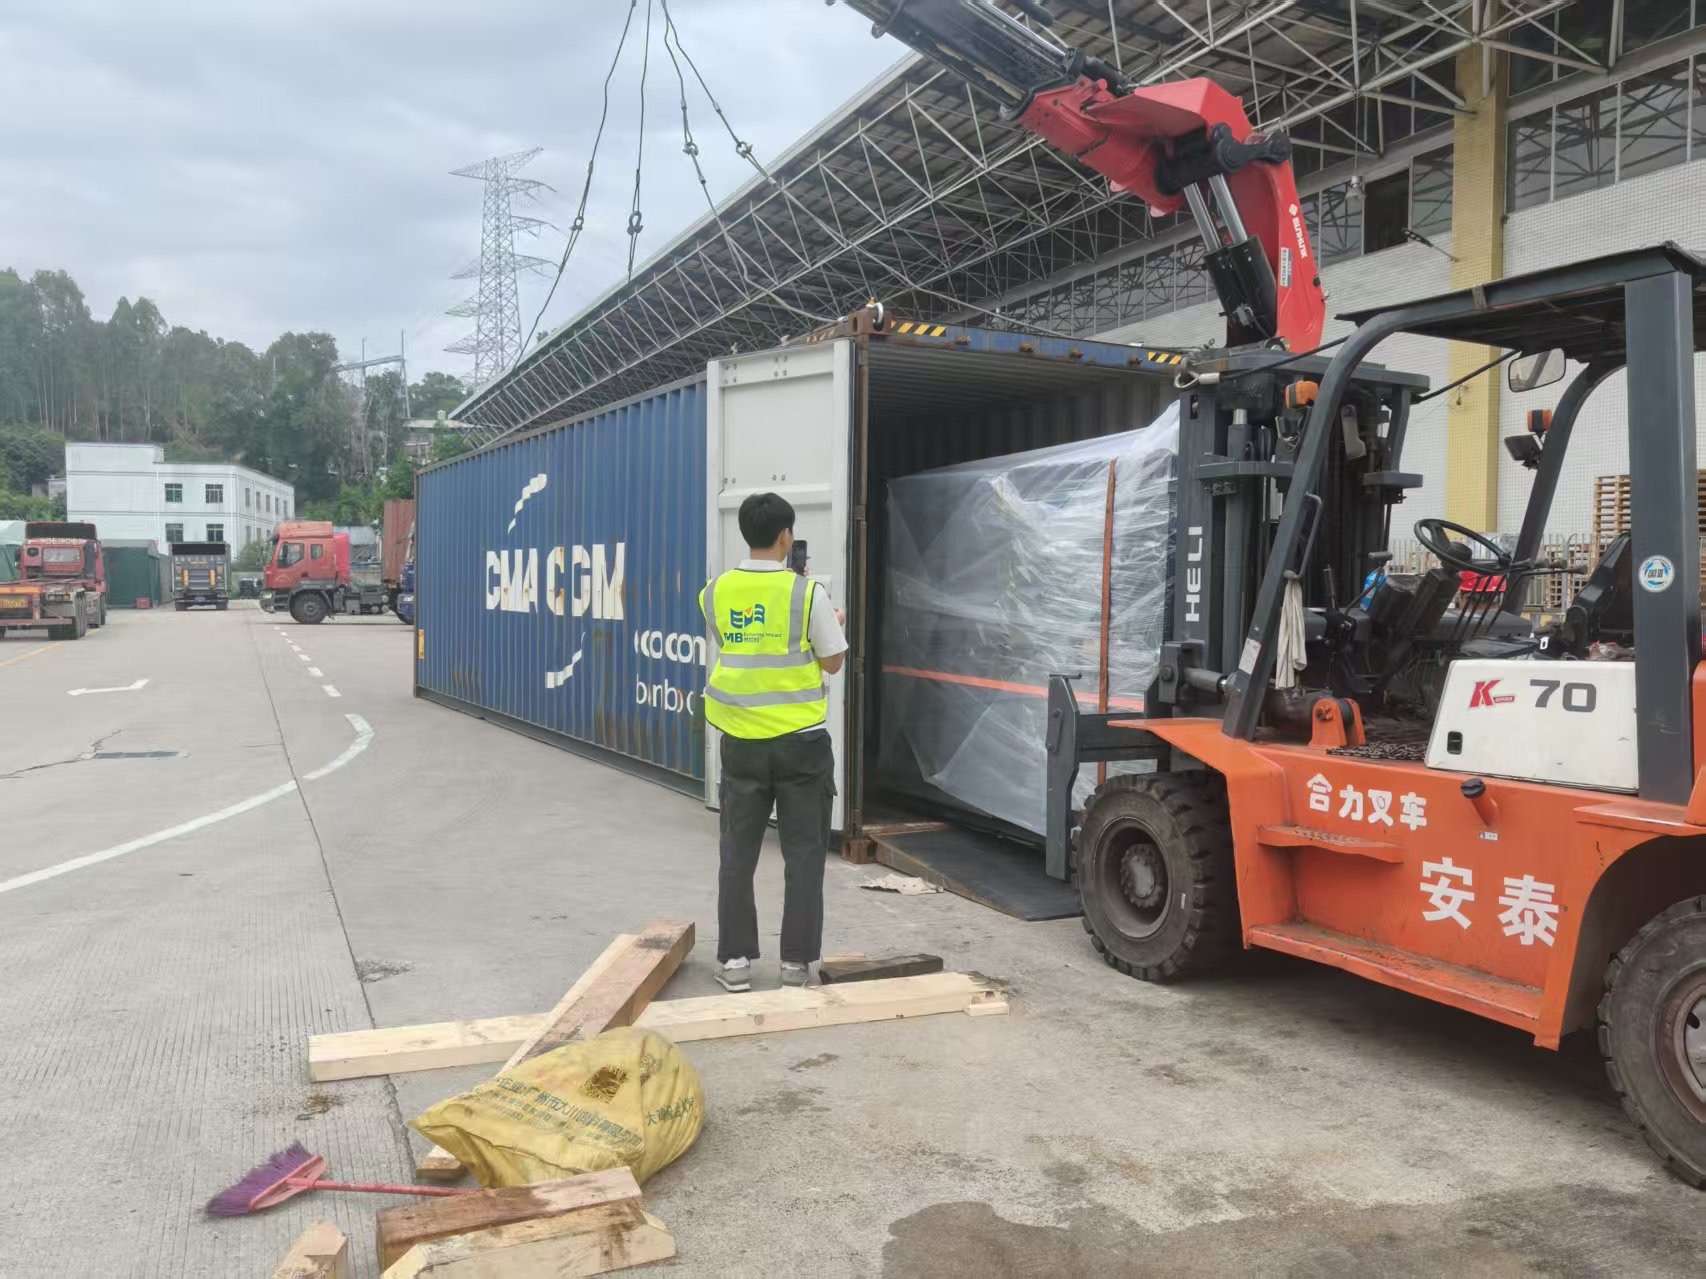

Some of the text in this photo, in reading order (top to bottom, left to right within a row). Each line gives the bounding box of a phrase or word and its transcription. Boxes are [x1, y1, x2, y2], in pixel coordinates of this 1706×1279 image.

[486, 542, 625, 620] CMA CGM
[1185, 526, 1203, 622] HELI
[1529, 679, 1597, 713] 70
[1306, 773, 1428, 831] 合力叉车
[1419, 856, 1559, 947] 安泰
